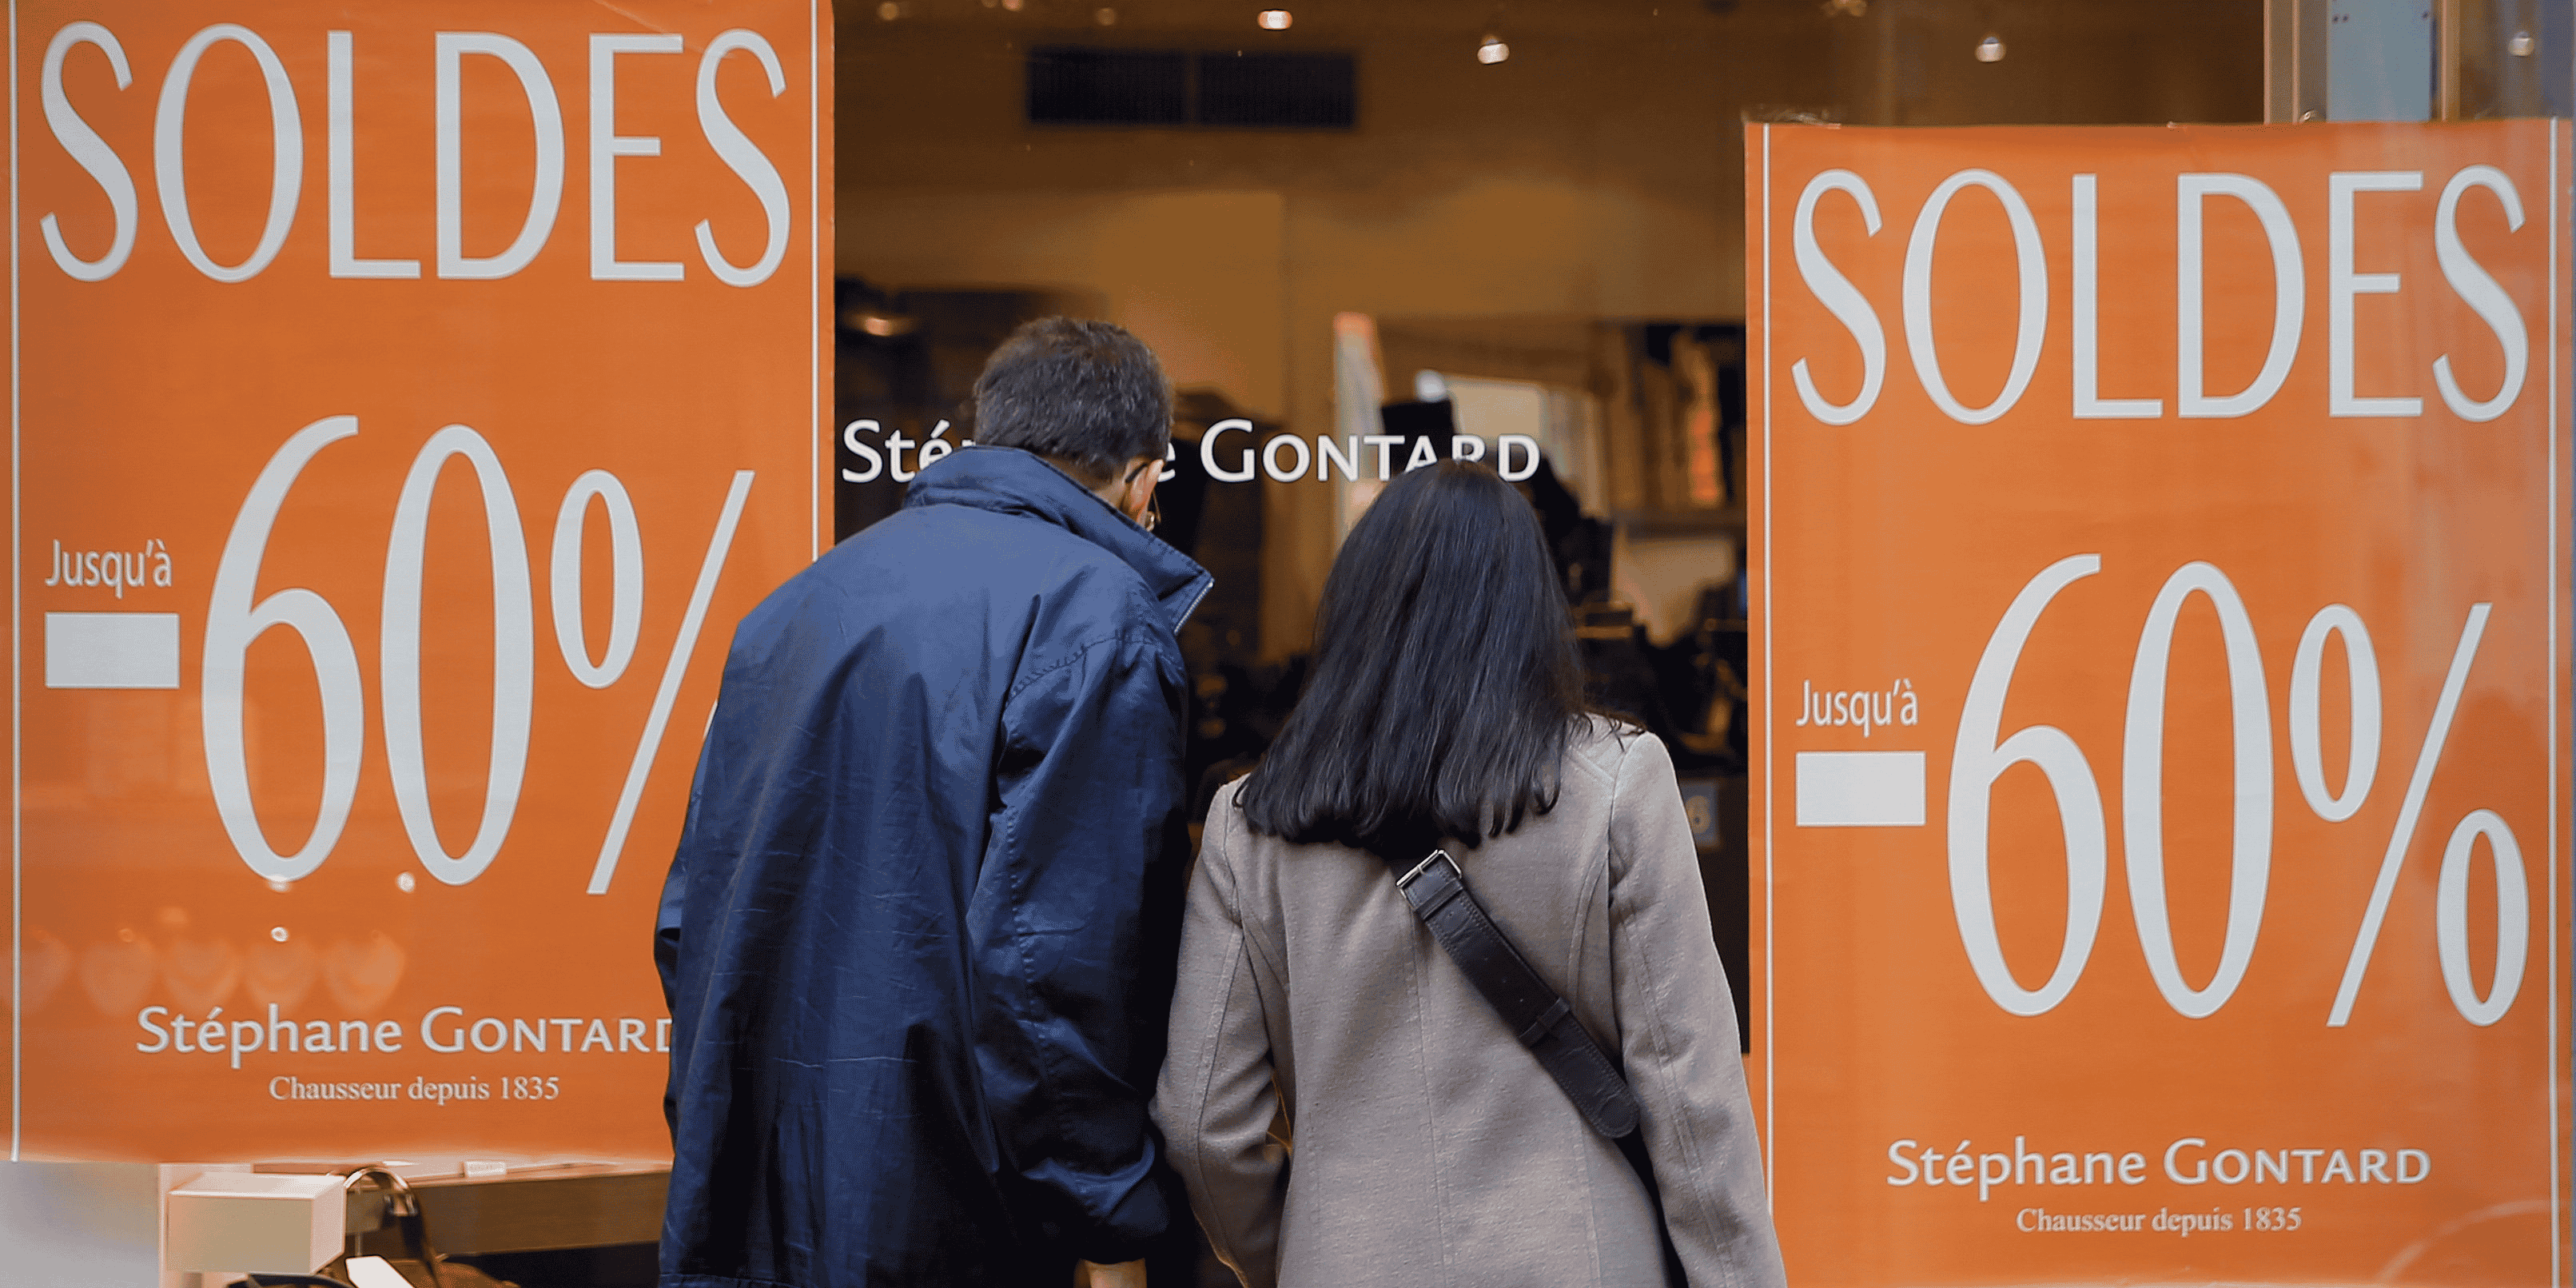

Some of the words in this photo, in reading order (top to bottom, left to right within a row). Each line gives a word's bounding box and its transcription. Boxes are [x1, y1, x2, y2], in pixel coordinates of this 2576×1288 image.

[40, 21, 792, 288] SOLDES
[1791, 164, 2530, 426] SOLDES
[45, 538, 173, 600] Jusqu'à
[1795, 678, 1919, 738] Jusqu'à
[1795, 553, 2530, 1027] -60%
[136, 1003, 403, 1071] Stéphane
[269, 1076, 401, 1100] Chausseur
[408, 1076, 491, 1106] depuis
[501, 1076, 560, 1101] 1835
[1886, 1135, 2147, 1202] Stéphane
[2164, 1138, 2431, 1185] GONTARD
[2016, 1208, 2147, 1232] Chausseur
[2151, 1207, 2234, 1238] depuis
[2244, 1206, 2302, 1231] 1835
